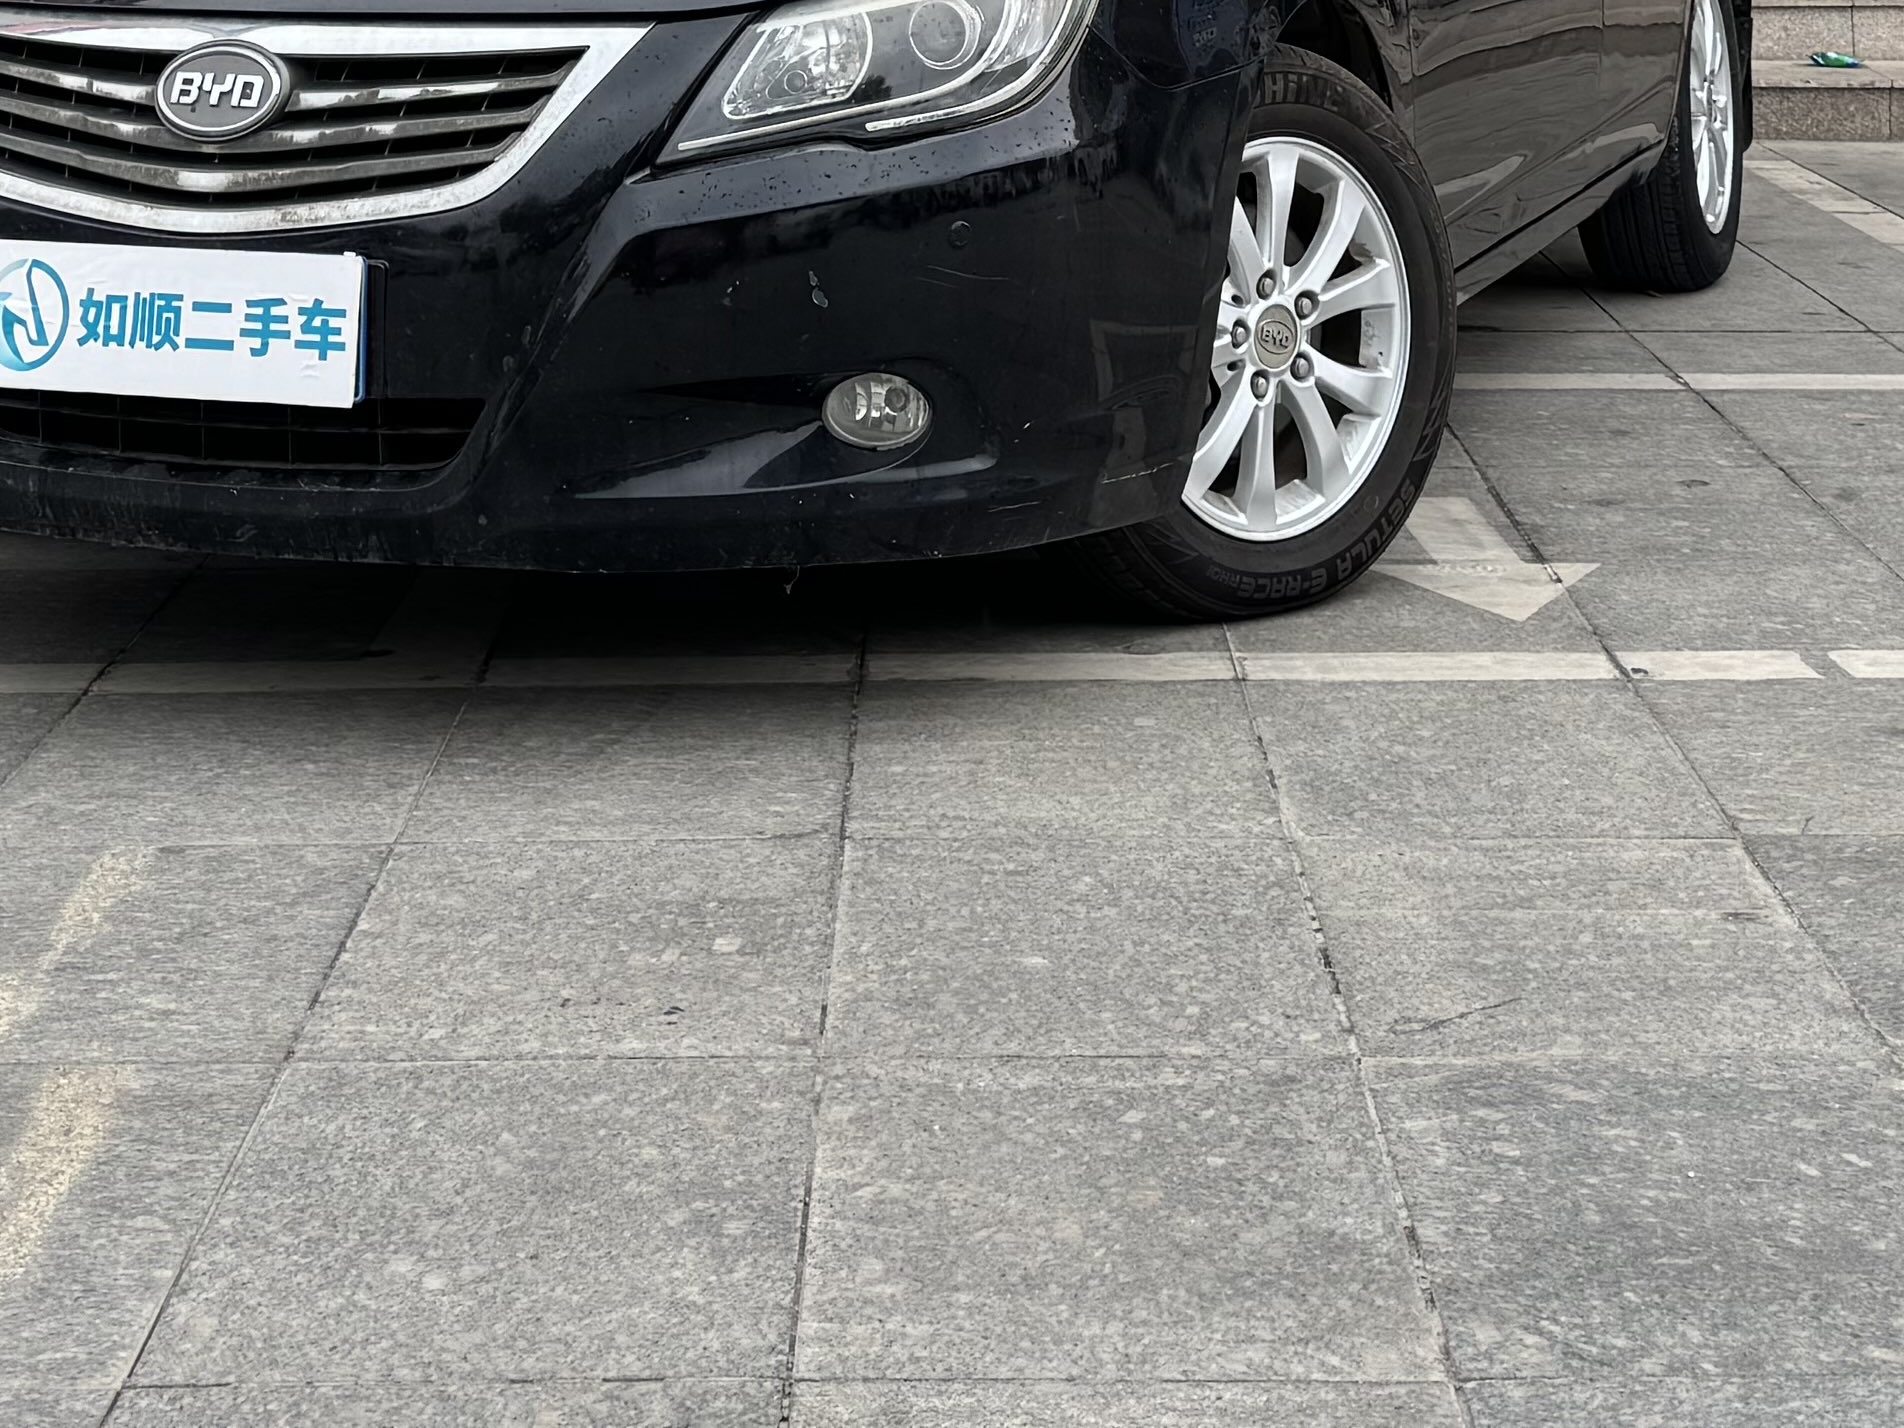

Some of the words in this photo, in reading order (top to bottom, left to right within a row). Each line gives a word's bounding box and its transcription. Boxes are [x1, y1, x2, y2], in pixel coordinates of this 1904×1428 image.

[170, 69, 265, 112] BYD
[75, 289, 347, 362] 如顺二手车
[1262, 324, 1290, 349] BYD
[1337, 476, 1416, 577] SETULA
[1236, 566, 1328, 600] E-RACE
